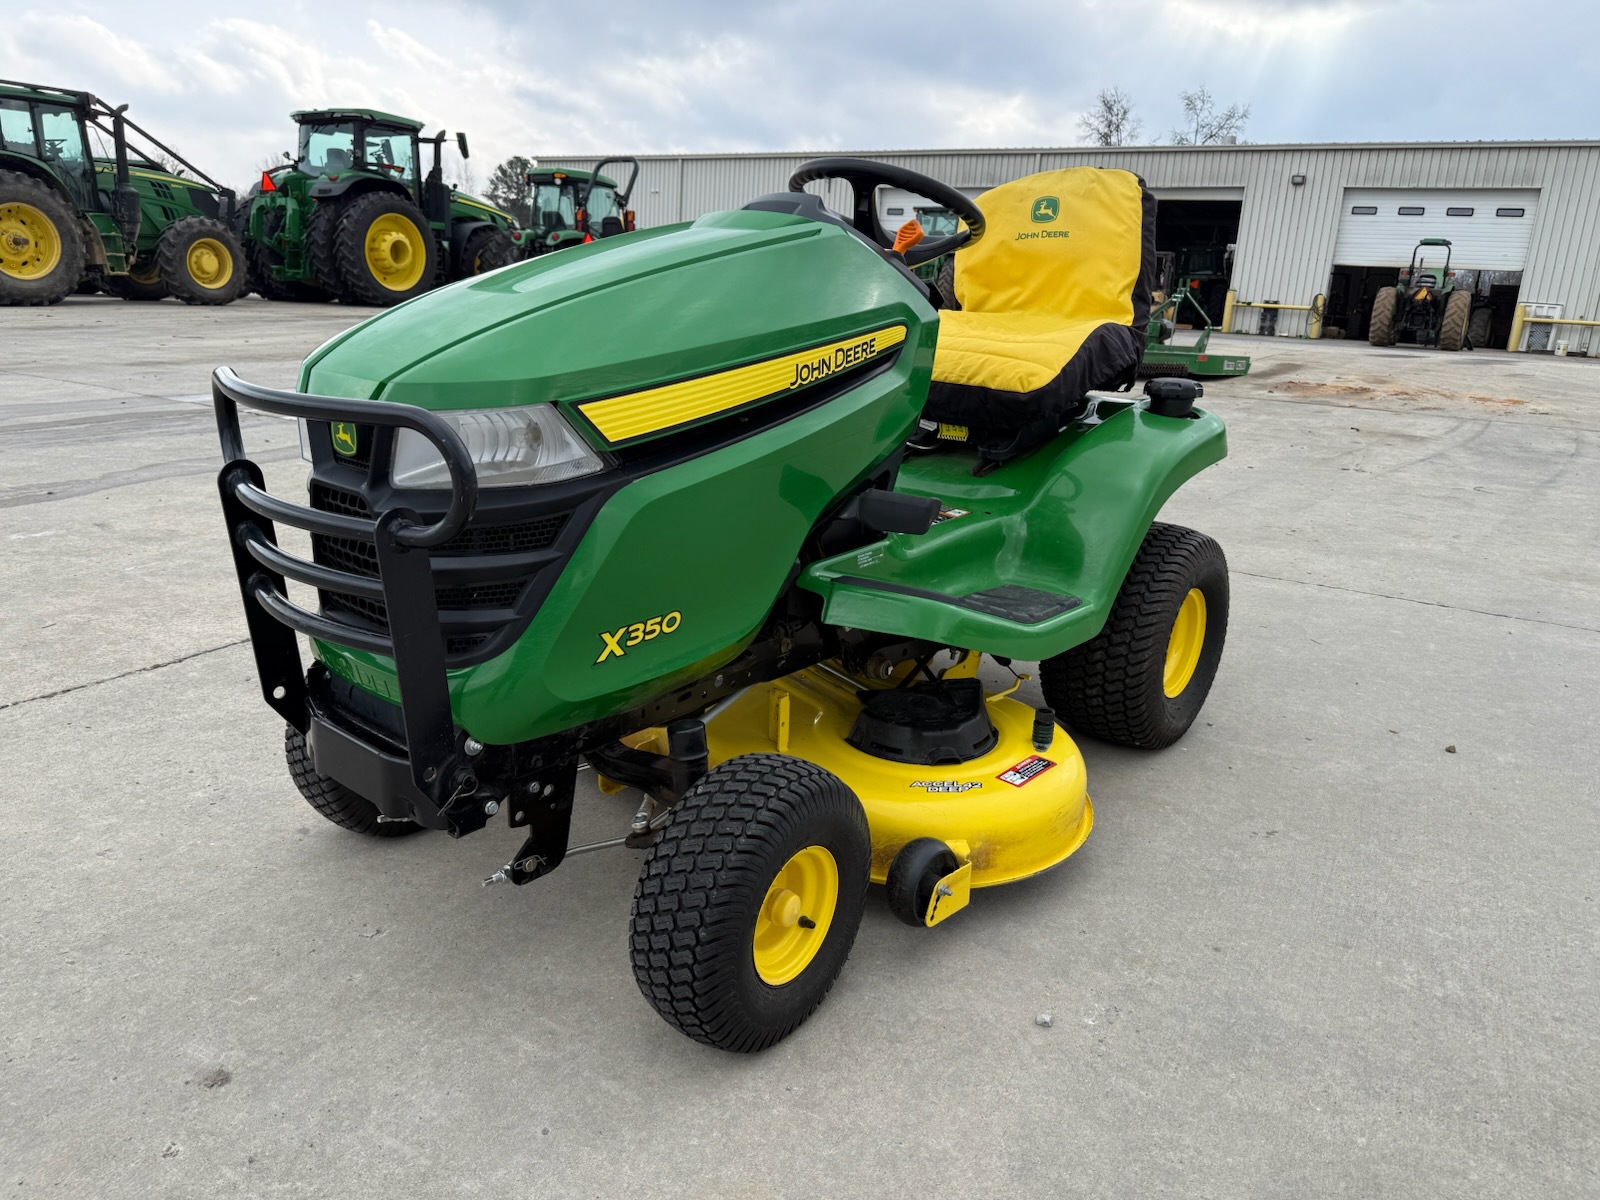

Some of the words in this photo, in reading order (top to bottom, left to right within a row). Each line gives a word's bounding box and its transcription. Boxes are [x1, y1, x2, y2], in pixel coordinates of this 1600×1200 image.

[1015, 232, 1039, 240] JOHN
[1041, 230, 1070, 238] DEERE
[789, 356, 831, 387] JOHN
[834, 338, 876, 369] DEERE
[593, 610, 682, 665] X350
[909, 780, 960, 788] ACCEL
